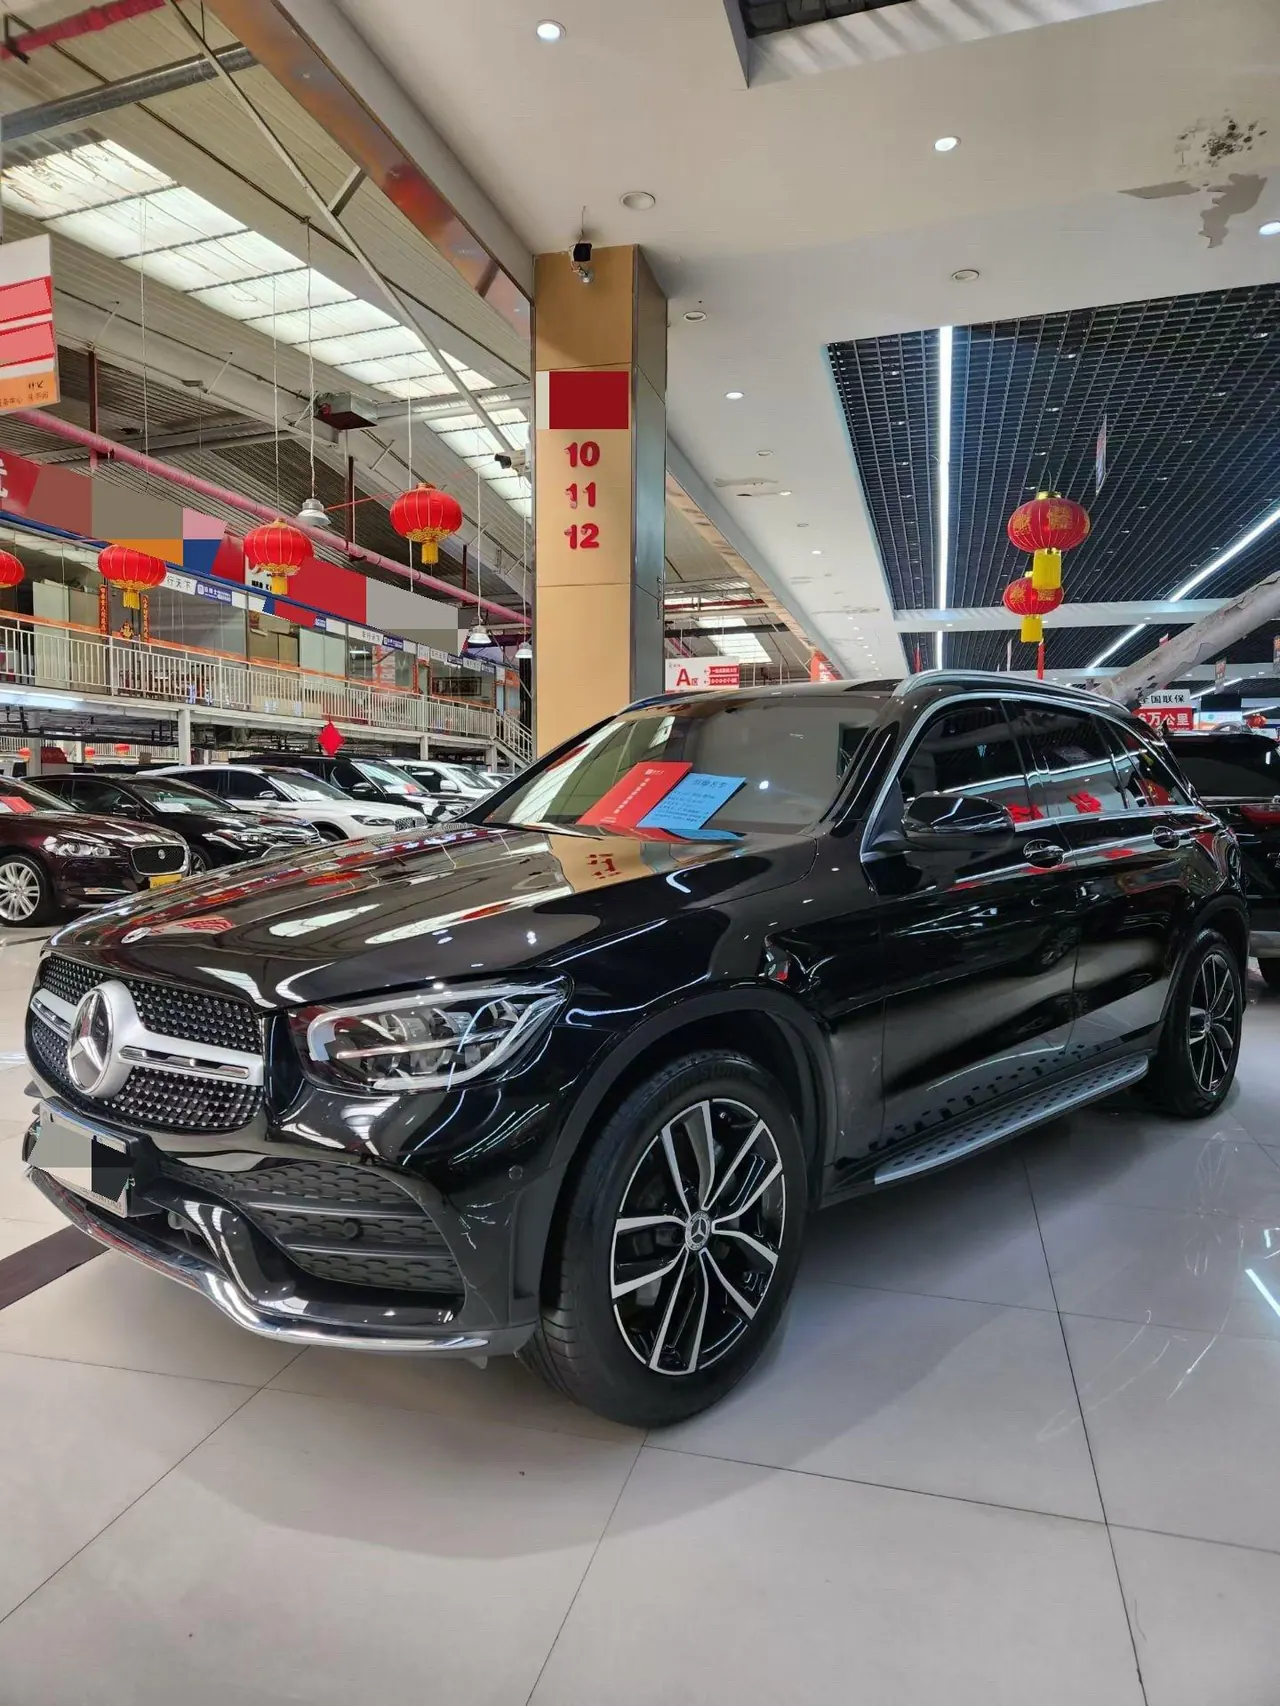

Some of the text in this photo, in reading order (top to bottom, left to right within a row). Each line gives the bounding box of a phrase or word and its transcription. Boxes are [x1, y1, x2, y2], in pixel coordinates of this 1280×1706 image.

[564, 441, 601, 468] 10
[564, 481, 597, 509] 11
[564, 523, 600, 550] 12
